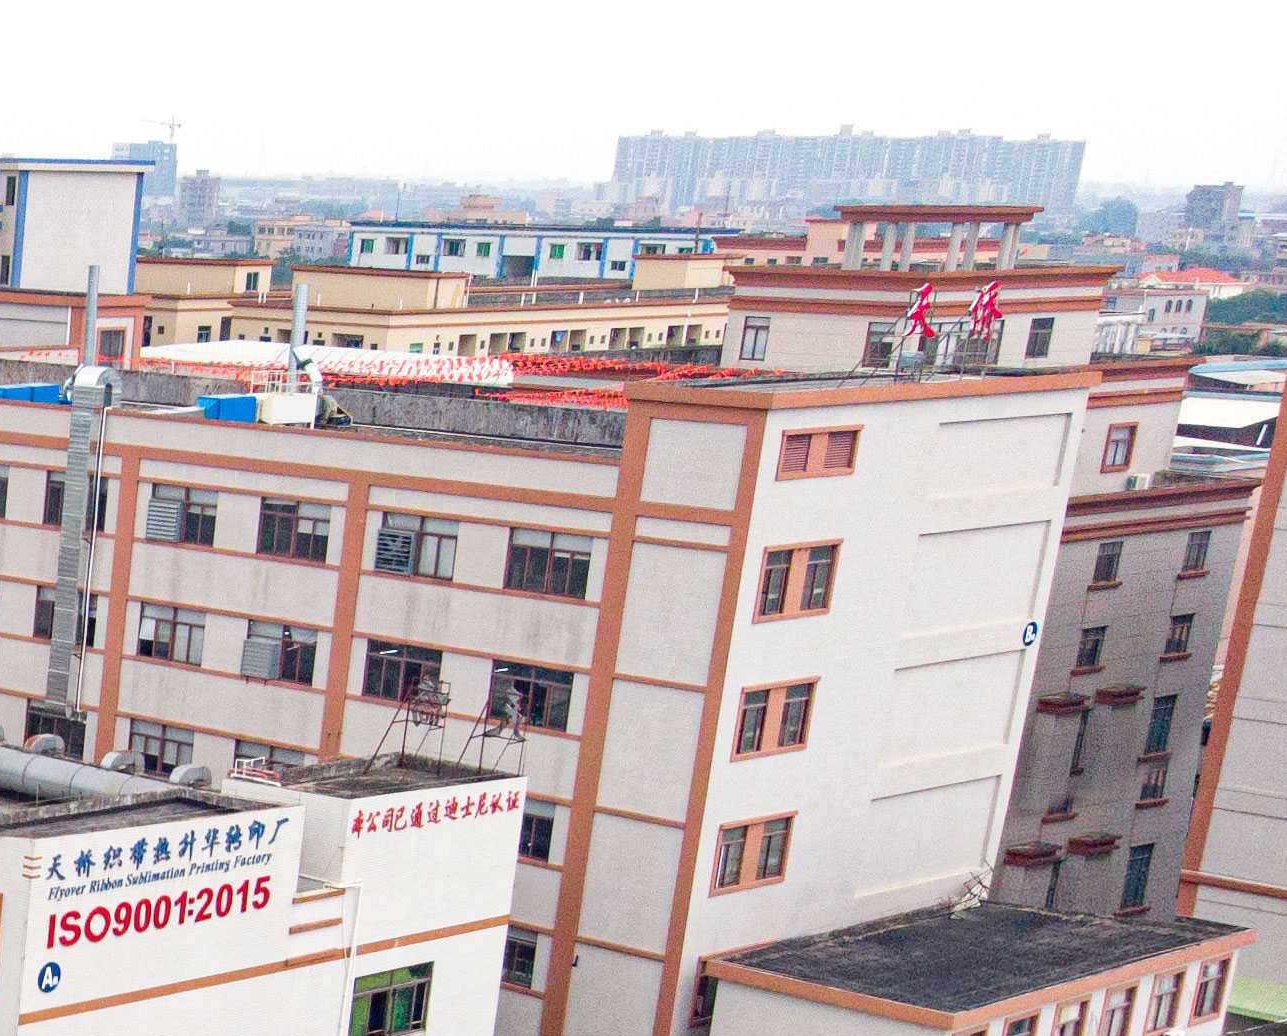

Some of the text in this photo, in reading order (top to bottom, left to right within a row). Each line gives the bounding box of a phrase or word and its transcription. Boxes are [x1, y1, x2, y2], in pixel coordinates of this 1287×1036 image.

[351, 790, 521, 839] 本公司已通过迪士尼认证
[48, 852, 273, 901] Flyover Ribbon Sublimation Printing Factory
[46, 875, 272, 949] ISO9001:2015
